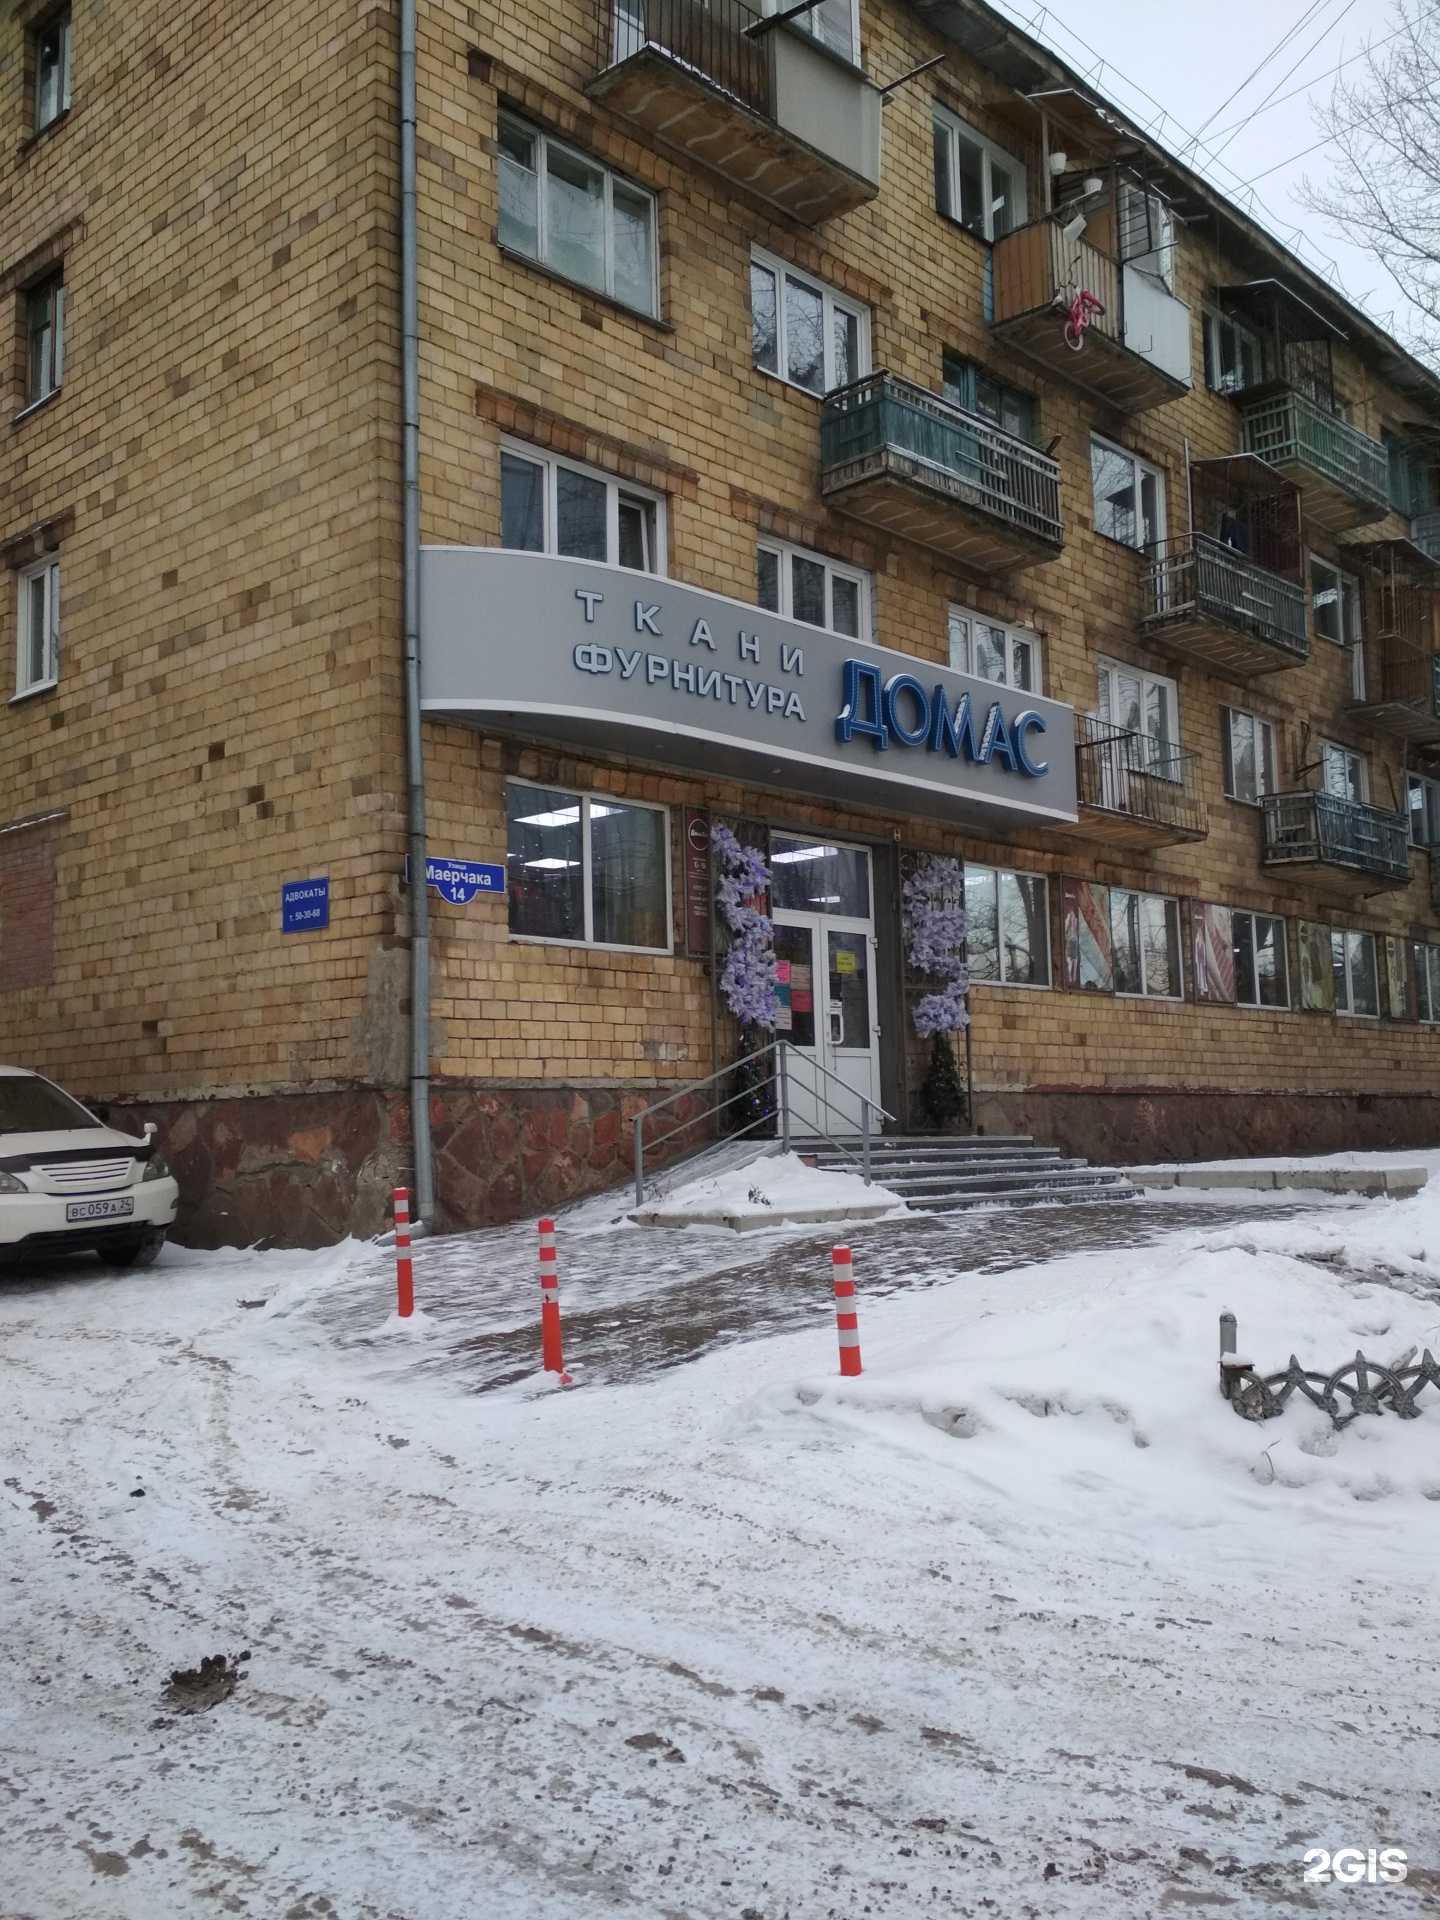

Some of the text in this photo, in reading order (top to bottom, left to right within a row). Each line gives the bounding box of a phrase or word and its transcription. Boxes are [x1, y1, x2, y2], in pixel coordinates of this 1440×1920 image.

[575, 589, 807, 676] ТКАНИ
[574, 642, 807, 721] ФУРНИТУРА
[835, 658, 1049, 778] ДОМАС
[285, 887, 326, 903] АДВОКАТЫ
[450, 887, 466, 901] 14
